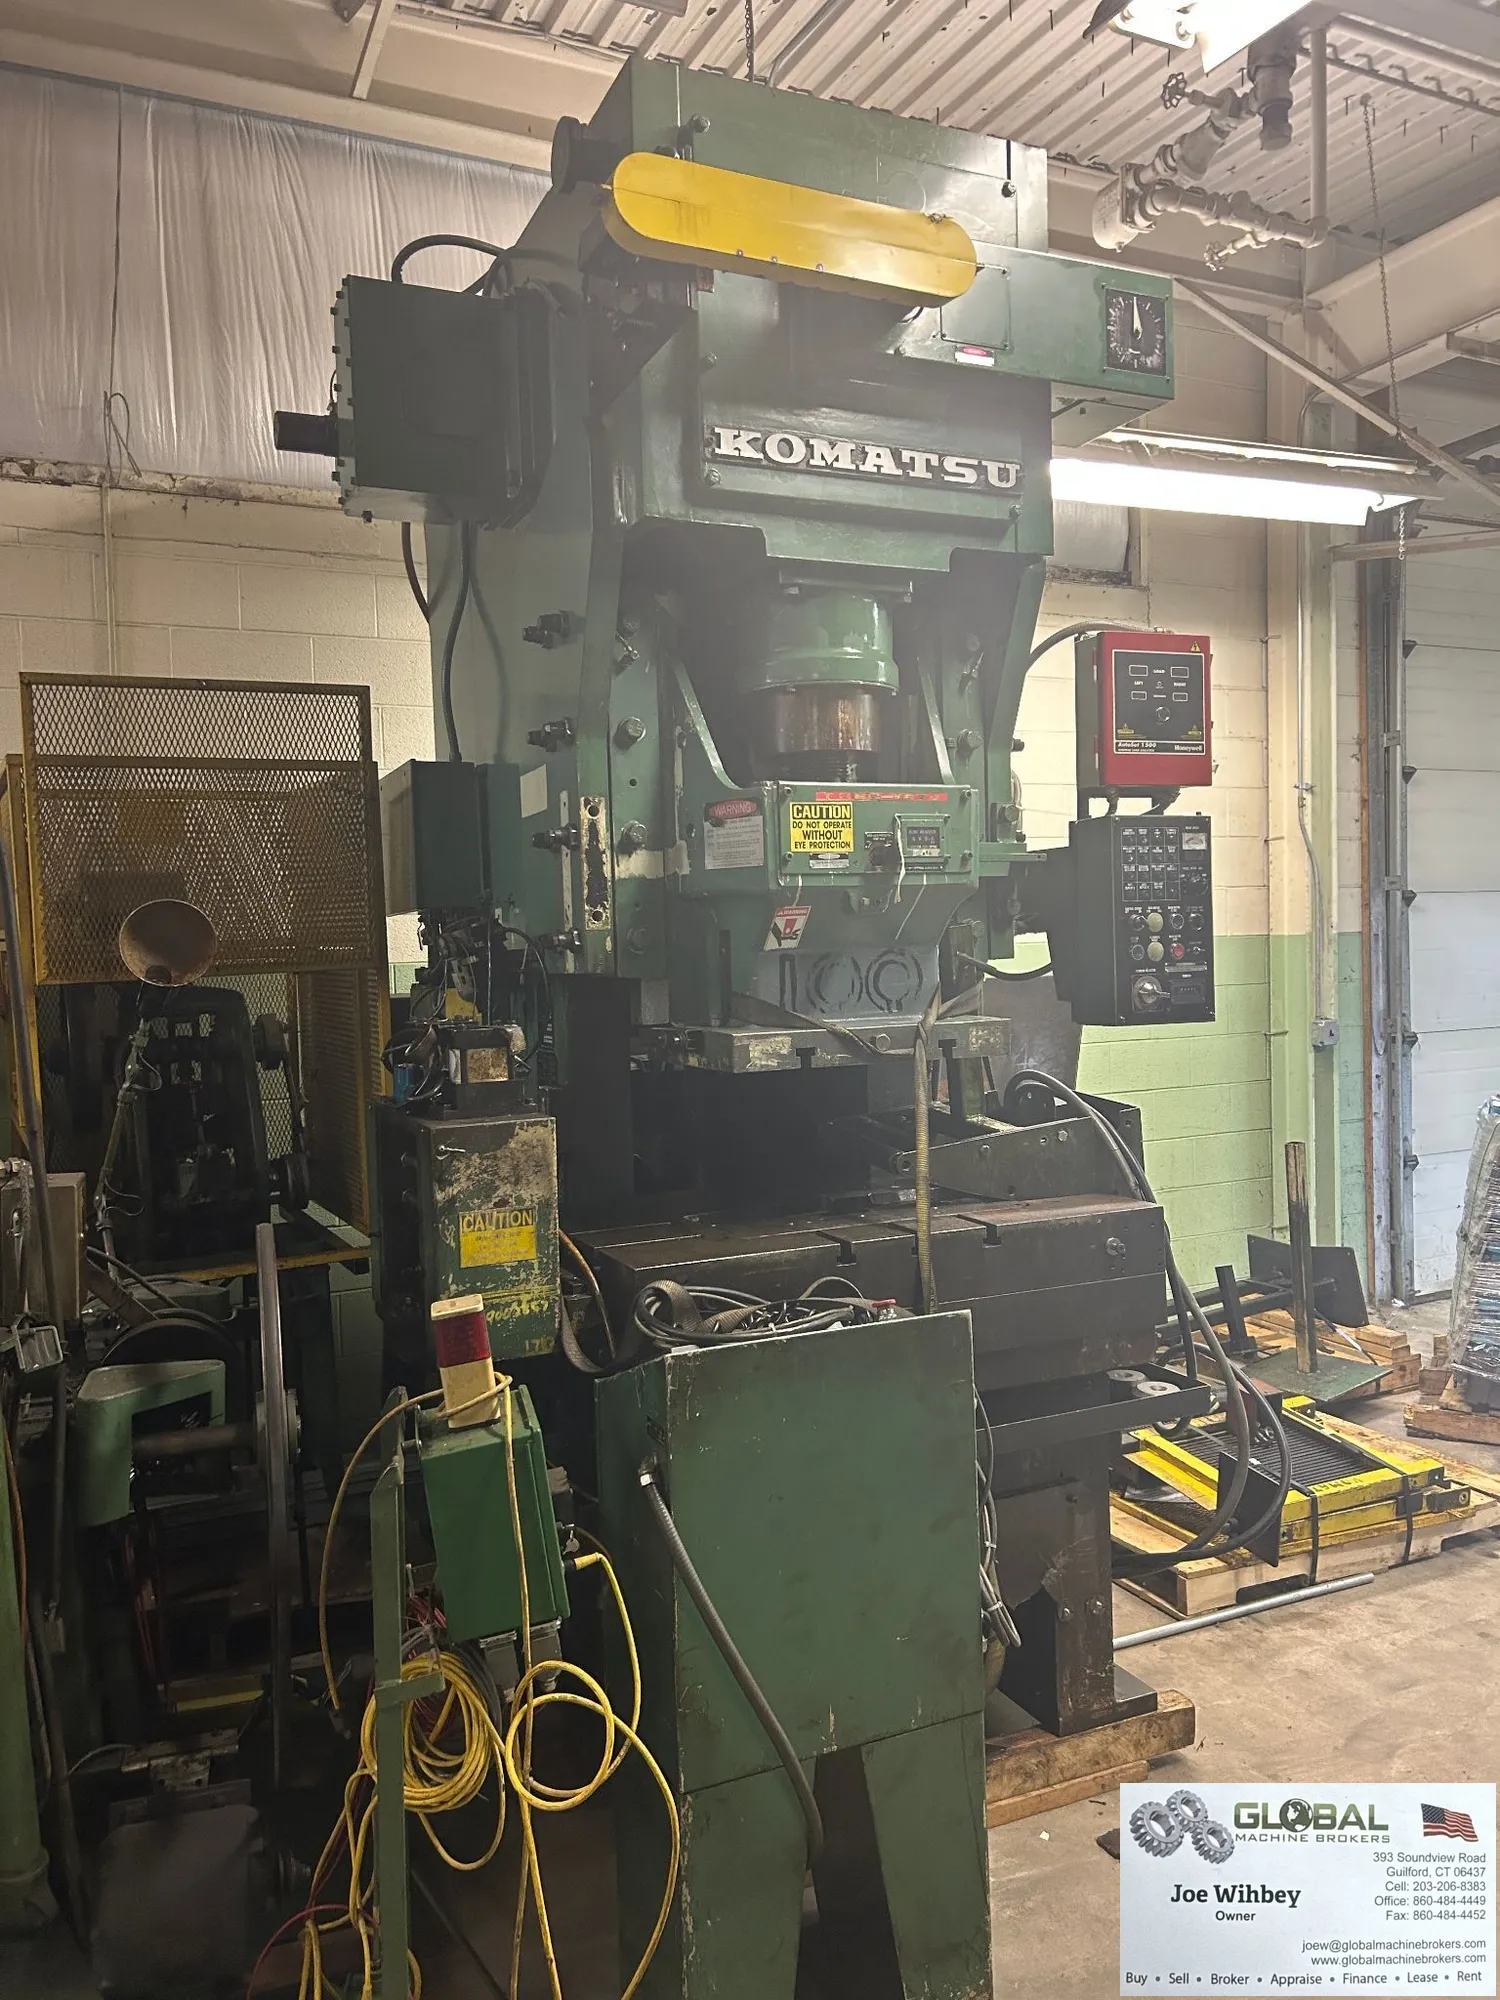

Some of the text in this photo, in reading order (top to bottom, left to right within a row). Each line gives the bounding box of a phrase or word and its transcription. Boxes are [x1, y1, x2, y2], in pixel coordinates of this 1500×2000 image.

[713, 427, 1020, 489] KOMATSU
[1174, 744, 1203, 752] Honeywell
[713, 802, 751, 816] WARNING
[793, 804, 851, 819] CAUTION
[792, 821, 852, 829] DO NOT OPERATE
[802, 830, 843, 840] WITHOUT
[794, 841, 851, 849] EYE PROTECTION
[462, 1209, 533, 1233] CAUTION
